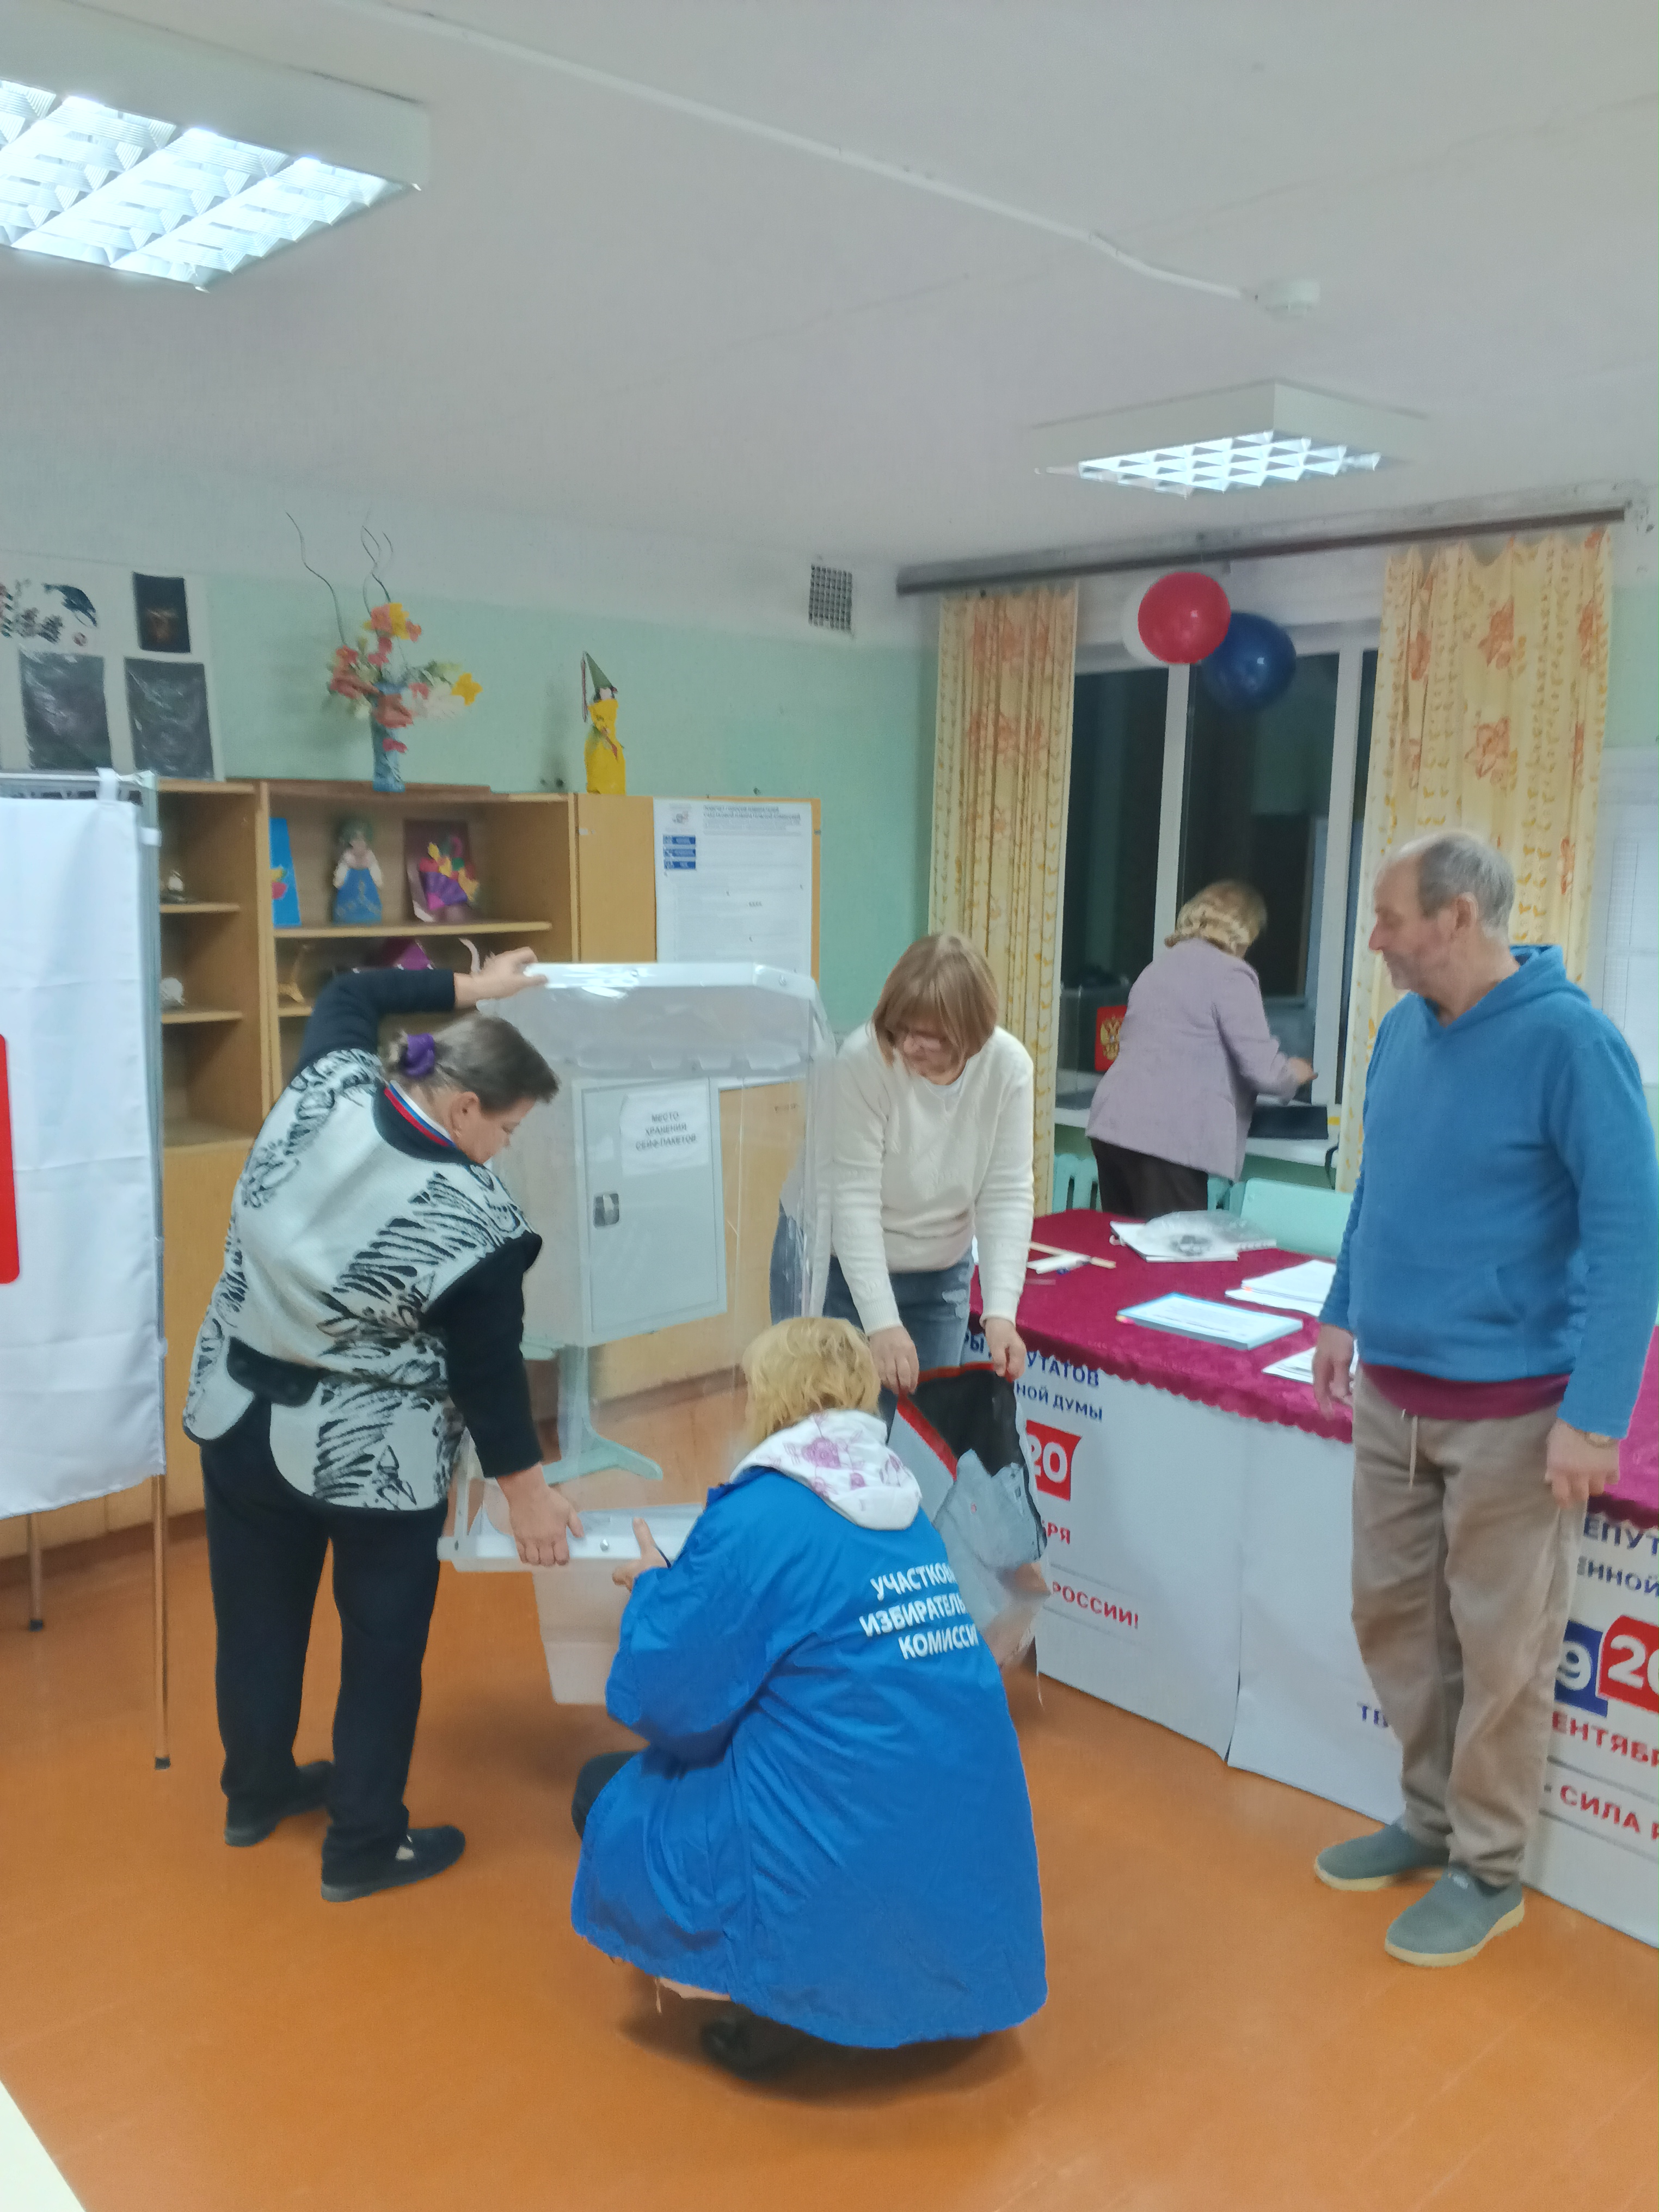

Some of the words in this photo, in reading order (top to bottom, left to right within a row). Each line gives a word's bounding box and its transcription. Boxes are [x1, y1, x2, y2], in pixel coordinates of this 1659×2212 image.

[645, 1122, 687, 1136] ХРАНЕНИЯ
[652, 1111, 679, 1123] МЕСТО
[1027, 1351, 1099, 1386] УТАТОВ
[1016, 1382, 1049, 1405] НОЙ
[1053, 1394, 1103, 1421] ДУМЫ
[1042, 1521, 1071, 1545] РЯ
[1583, 1515, 1659, 1556] ЕПУТ
[870, 1562, 958, 1601] УЧАСТКОВ
[859, 1592, 967, 1637] ИЗБИРАТЕЛЬ
[1052, 1581, 1139, 1630] РОССИИ!
[898, 1623, 979, 1660] КОМИССИ
[1552, 1710, 1659, 1767] ЕНТЯБР
[1560, 1785, 1640, 1833] СИЛА
